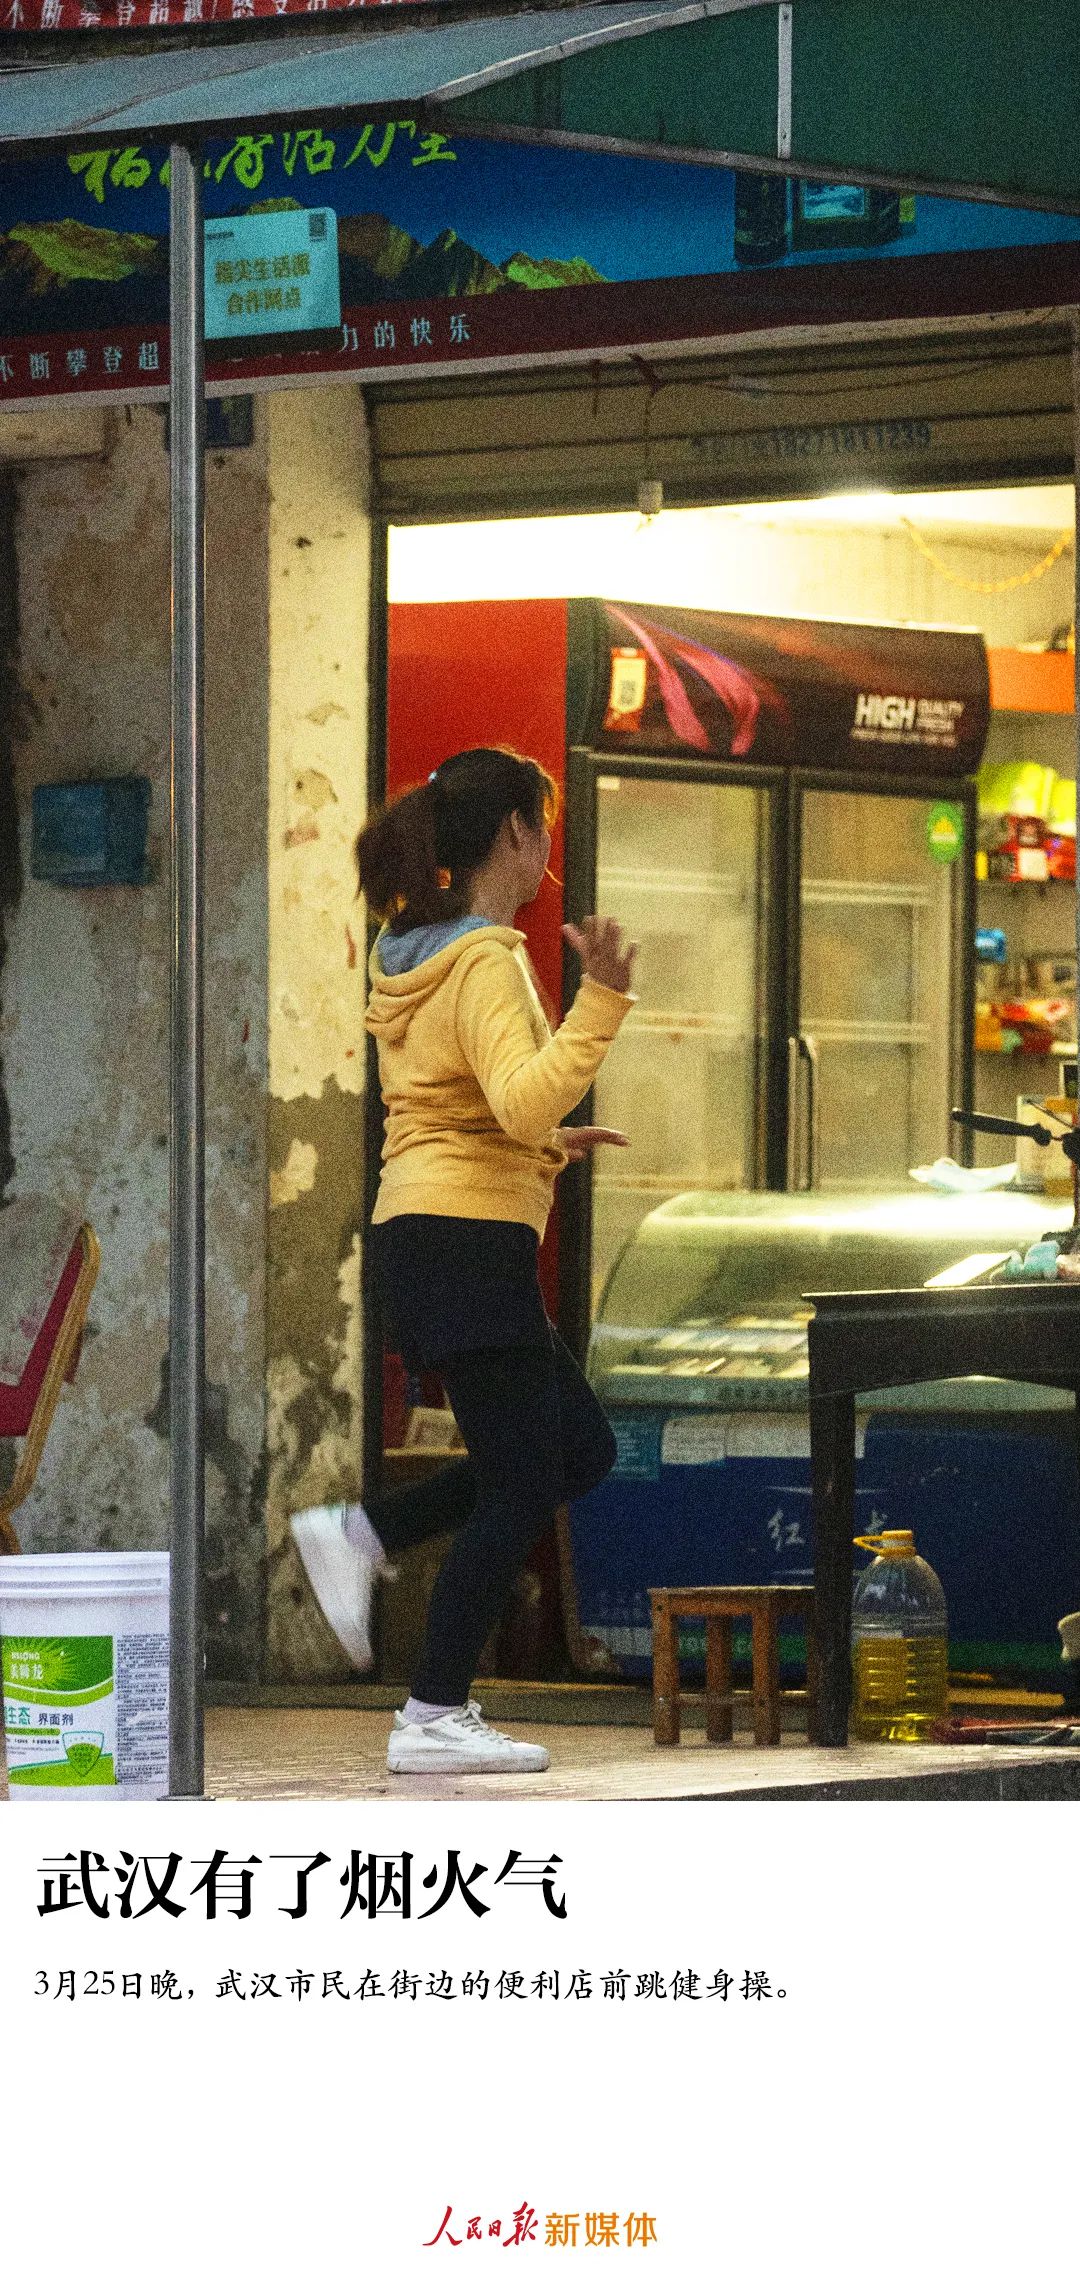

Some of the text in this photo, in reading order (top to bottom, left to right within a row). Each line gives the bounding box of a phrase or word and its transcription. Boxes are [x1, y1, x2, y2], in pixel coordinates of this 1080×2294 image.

[855, 692, 916, 729] HIGH
[4, 1705, 74, 1726] 生态 界面剂
